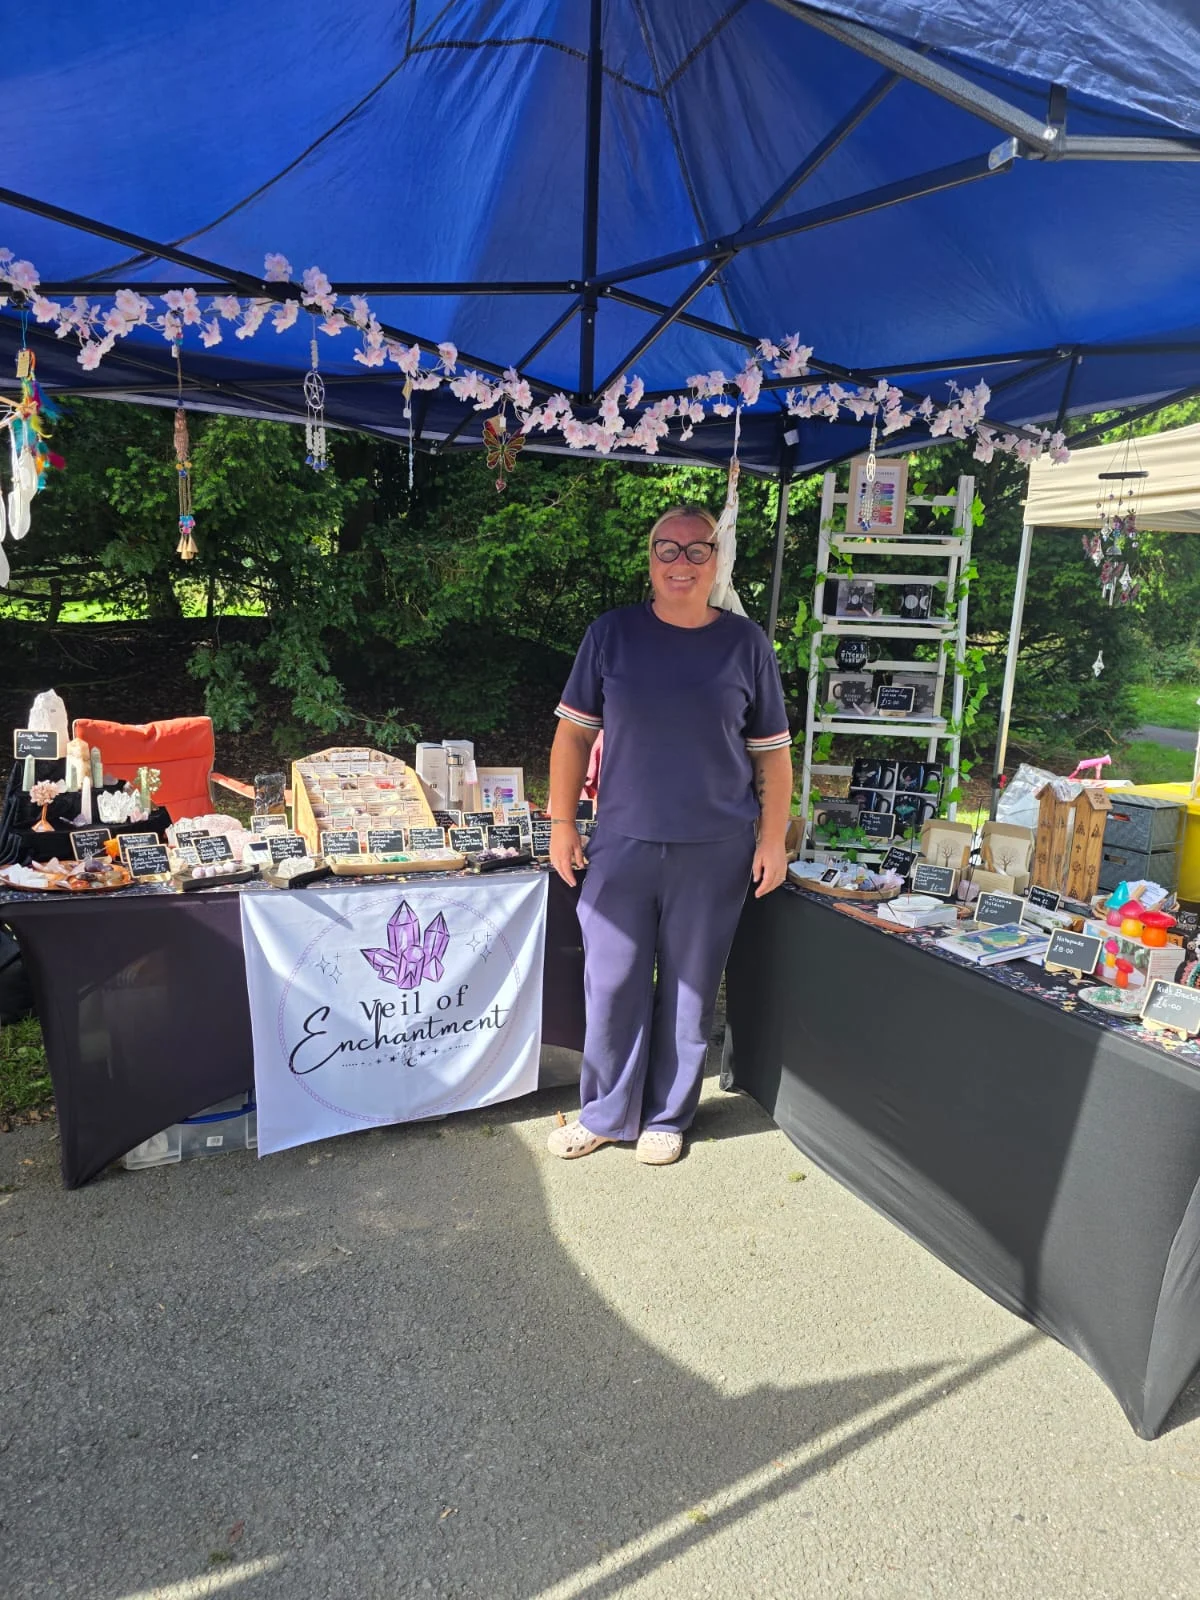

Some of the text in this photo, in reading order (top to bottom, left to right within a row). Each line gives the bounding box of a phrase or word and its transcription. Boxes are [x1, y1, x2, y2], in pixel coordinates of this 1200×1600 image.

[359, 984, 469, 1021] Veil of
[288, 1000, 510, 1075] Enchantment
